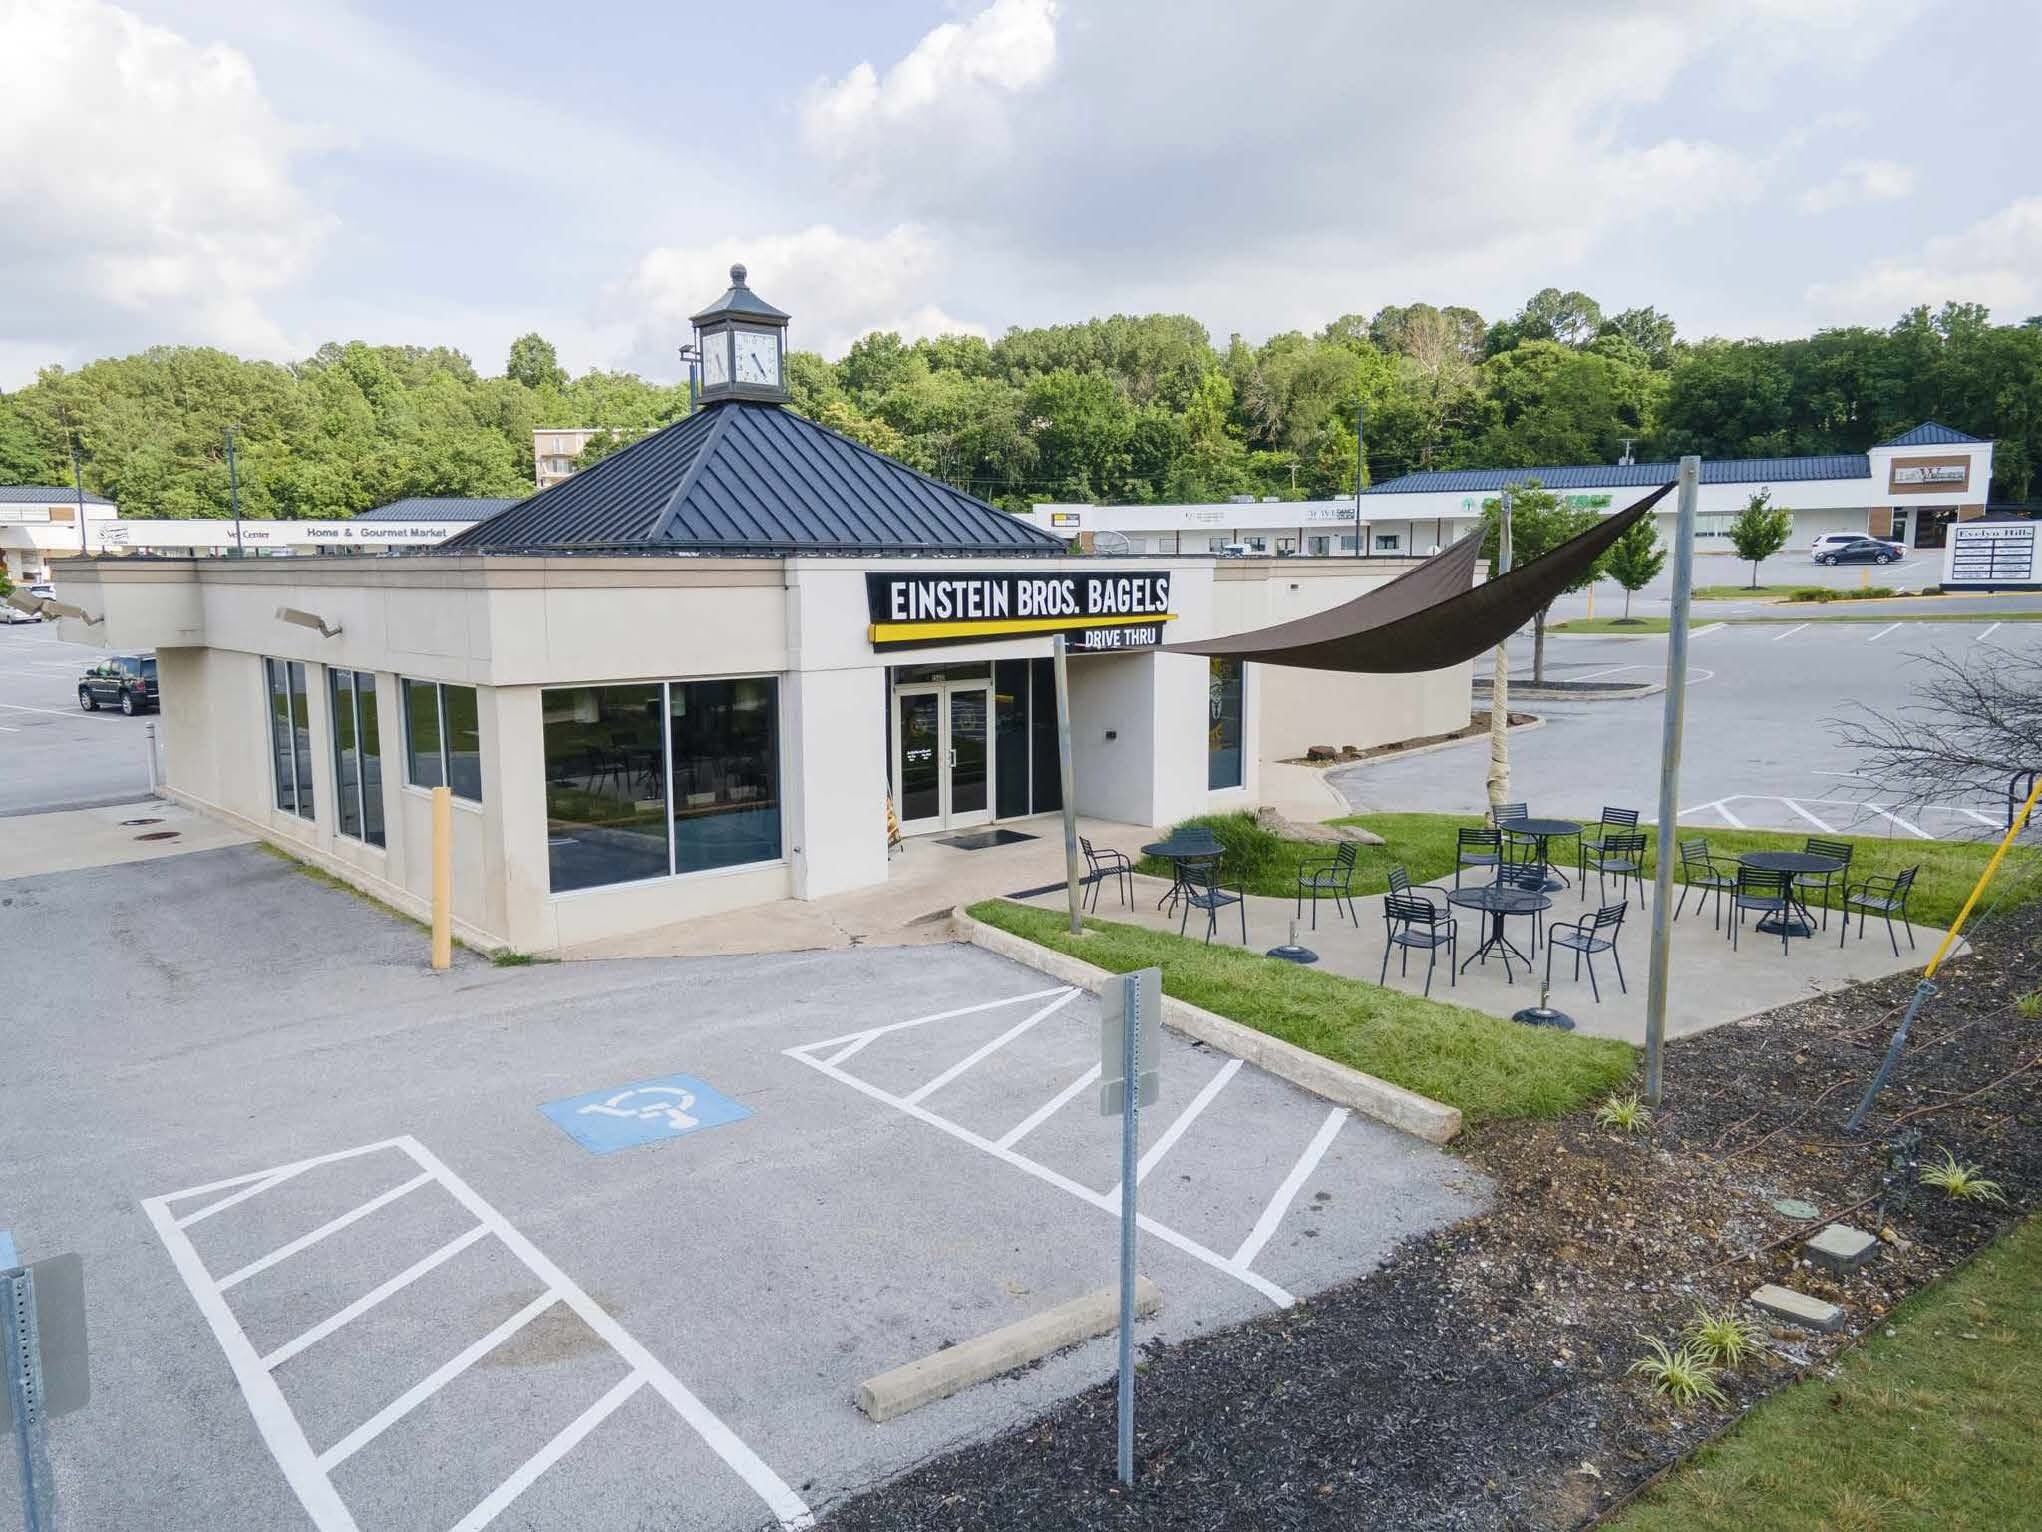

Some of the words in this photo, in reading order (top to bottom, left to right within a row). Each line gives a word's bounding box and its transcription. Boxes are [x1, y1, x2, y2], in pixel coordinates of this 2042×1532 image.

[242, 530, 270, 539] Center
[307, 527, 338, 538] Home
[344, 527, 353, 537] &
[360, 527, 408, 538] Gourmet
[410, 527, 447, 537] Market
[1960, 529, 2000, 539] Evelyn
[2004, 528, 2033, 537] Hills
[890, 579, 1009, 620] EINSTEIN
[1018, 579, 1080, 616] BROS.
[1088, 577, 1169, 614] BAGELS
[1085, 628, 1121, 648] DRIVE
[1123, 627, 1156, 645] THRU
